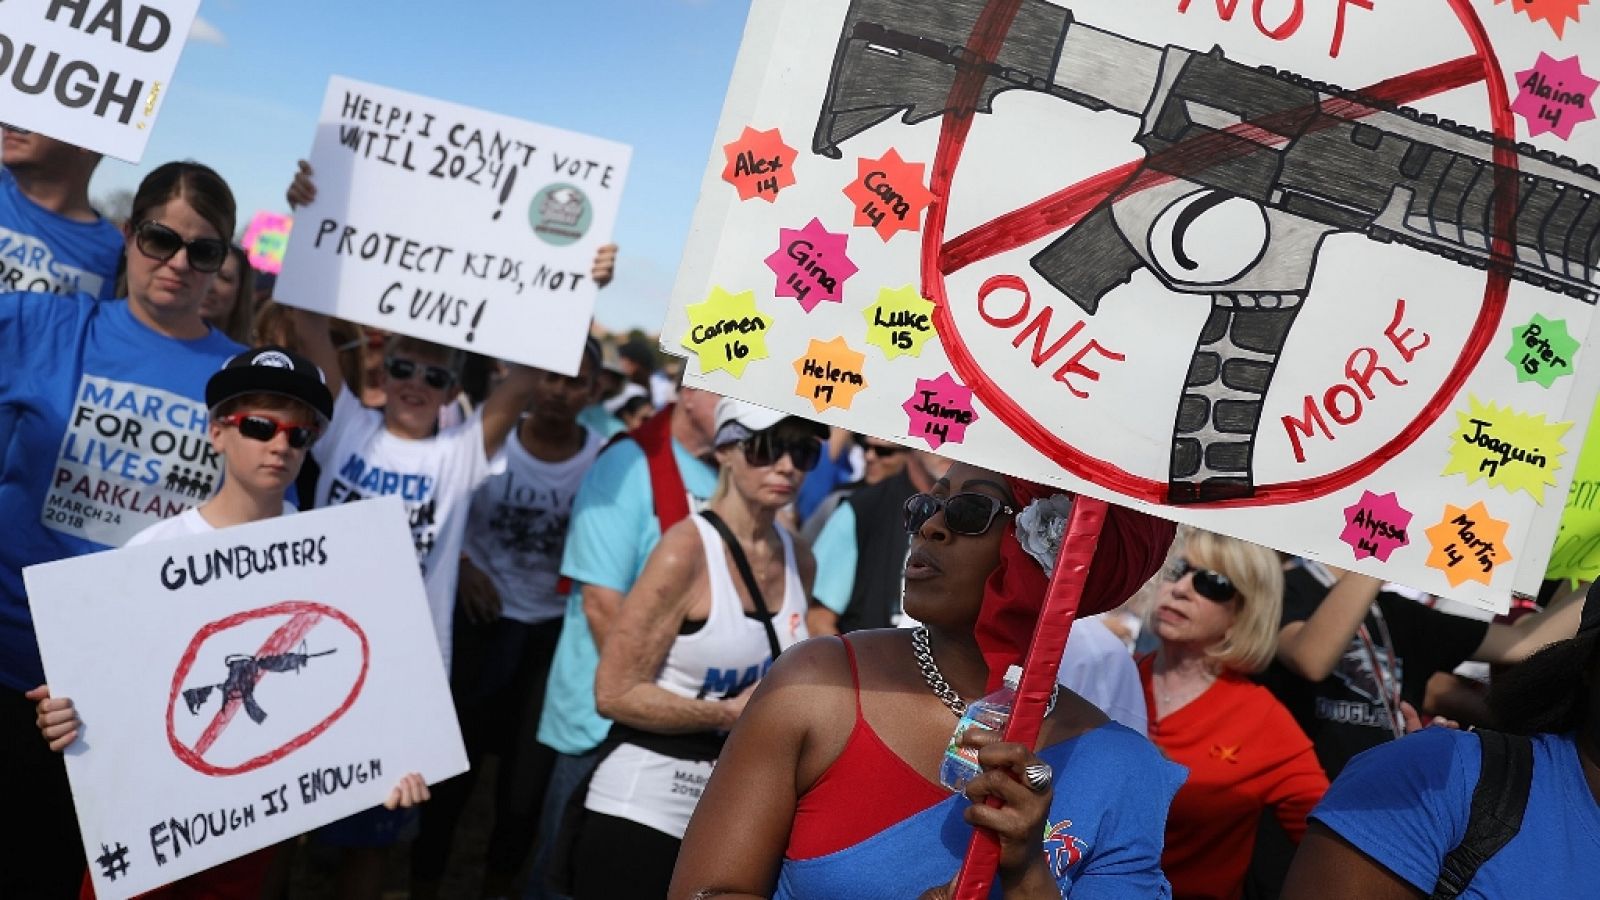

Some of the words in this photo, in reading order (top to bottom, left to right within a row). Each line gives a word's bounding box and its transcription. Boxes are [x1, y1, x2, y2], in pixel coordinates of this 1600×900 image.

[45, 0, 171, 53] HAD
[1522, 71, 1586, 108] Alaina
[1537, 106, 1563, 128] 14
[341, 91, 412, 134] HELP!
[417, 113, 436, 138] I
[448, 123, 537, 167] CAN'T
[552, 152, 615, 189] VOTE
[734, 150, 783, 177] Alex
[428, 145, 518, 220] 2024!
[757, 177, 779, 194] 14
[864, 171, 911, 221] Cara
[862, 201, 887, 227] 14
[315, 219, 453, 273] PROTECT
[462, 251, 526, 294] KIDS,
[532, 264, 586, 292] NOT
[786, 240, 838, 295] Gina
[786, 273, 812, 301] 14
[378, 282, 487, 343] GUNS!
[691, 315, 765, 345] Carmen
[873, 306, 930, 332] Luke
[725, 340, 750, 361] 16
[891, 330, 913, 349] 15
[977, 274, 1127, 399] ONE
[1521, 323, 1567, 368] Peter
[802, 358, 864, 387] Helena
[1280, 298, 1432, 464] MORE
[1520, 353, 1540, 375] 15
[81, 382, 209, 434] MARCH
[813, 385, 834, 403] 17
[914, 390, 973, 425] Jaime
[74, 405, 140, 448] FOR
[151, 430, 219, 470] OUR
[924, 421, 949, 443] 14
[1463, 419, 1547, 468] Joaquin
[61, 433, 163, 486] LIVES
[340, 453, 432, 502] MARCH
[1479, 457, 1499, 478] 17
[49, 493, 101, 525] MARCH
[104, 507, 122, 525] 24
[54, 467, 194, 521] PARKLAN
[45, 507, 84, 529] 2018
[1352, 508, 1406, 543] Alyssa
[1357, 537, 1378, 557] 14
[1443, 543, 1465, 567] 14
[1450, 513, 1497, 573] Martin
[161, 536, 328, 591] GUNBUSTERS
[149, 803, 256, 867] ENOUGH
[261, 784, 289, 817] IS
[299, 758, 382, 805] ENOUGH
